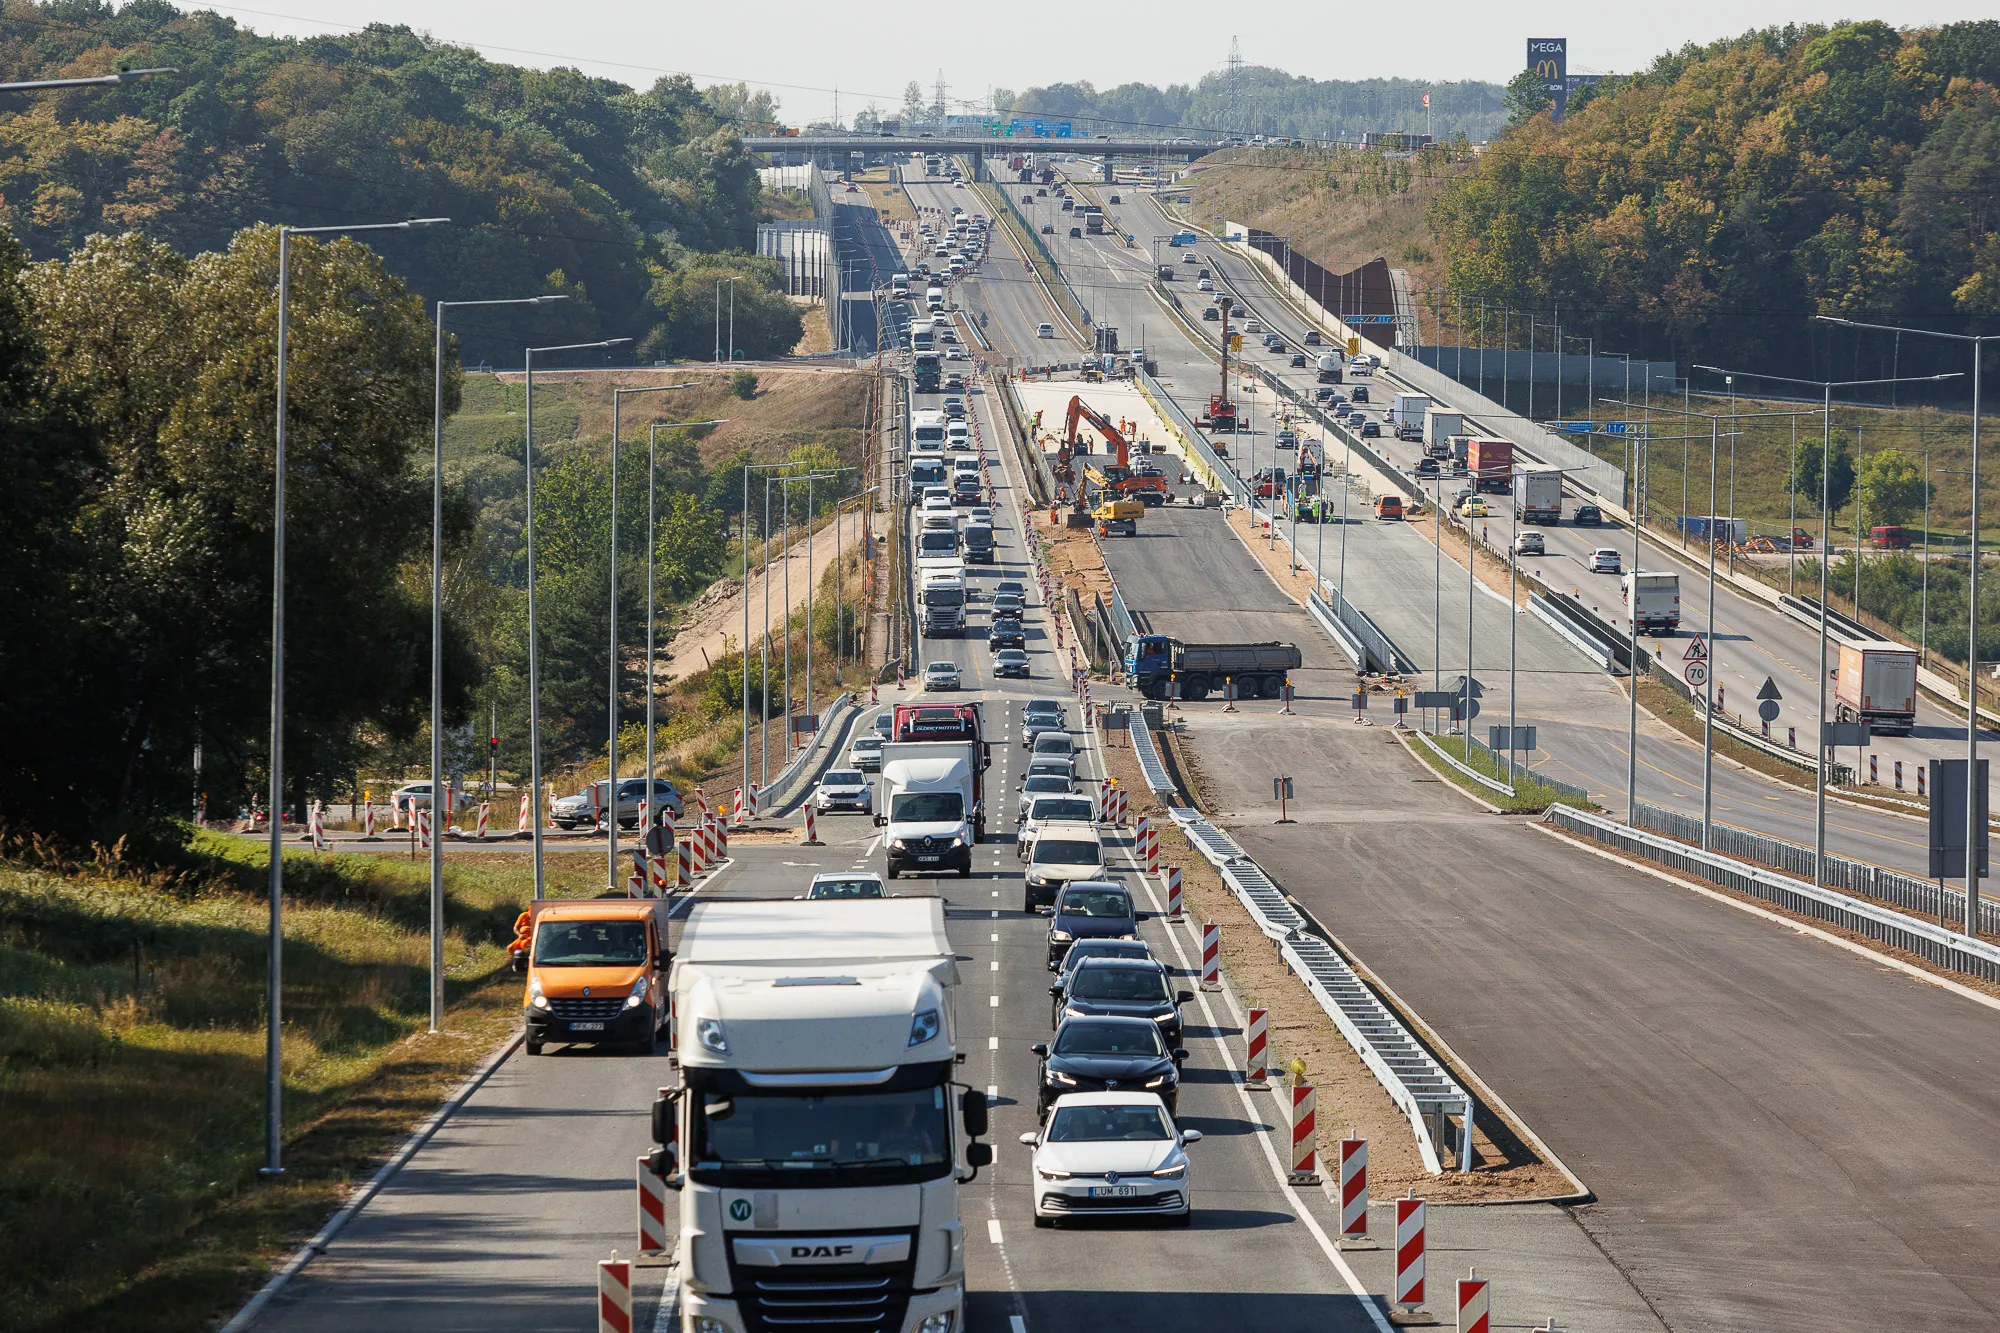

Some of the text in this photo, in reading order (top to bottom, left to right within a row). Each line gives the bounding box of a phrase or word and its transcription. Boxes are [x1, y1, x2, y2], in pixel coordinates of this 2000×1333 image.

[1531, 43, 1563, 52] MEGA
[1690, 669, 1704, 679] 70
[1095, 1187, 1134, 1195] LUM 691
[790, 1245, 854, 1258] DAF
